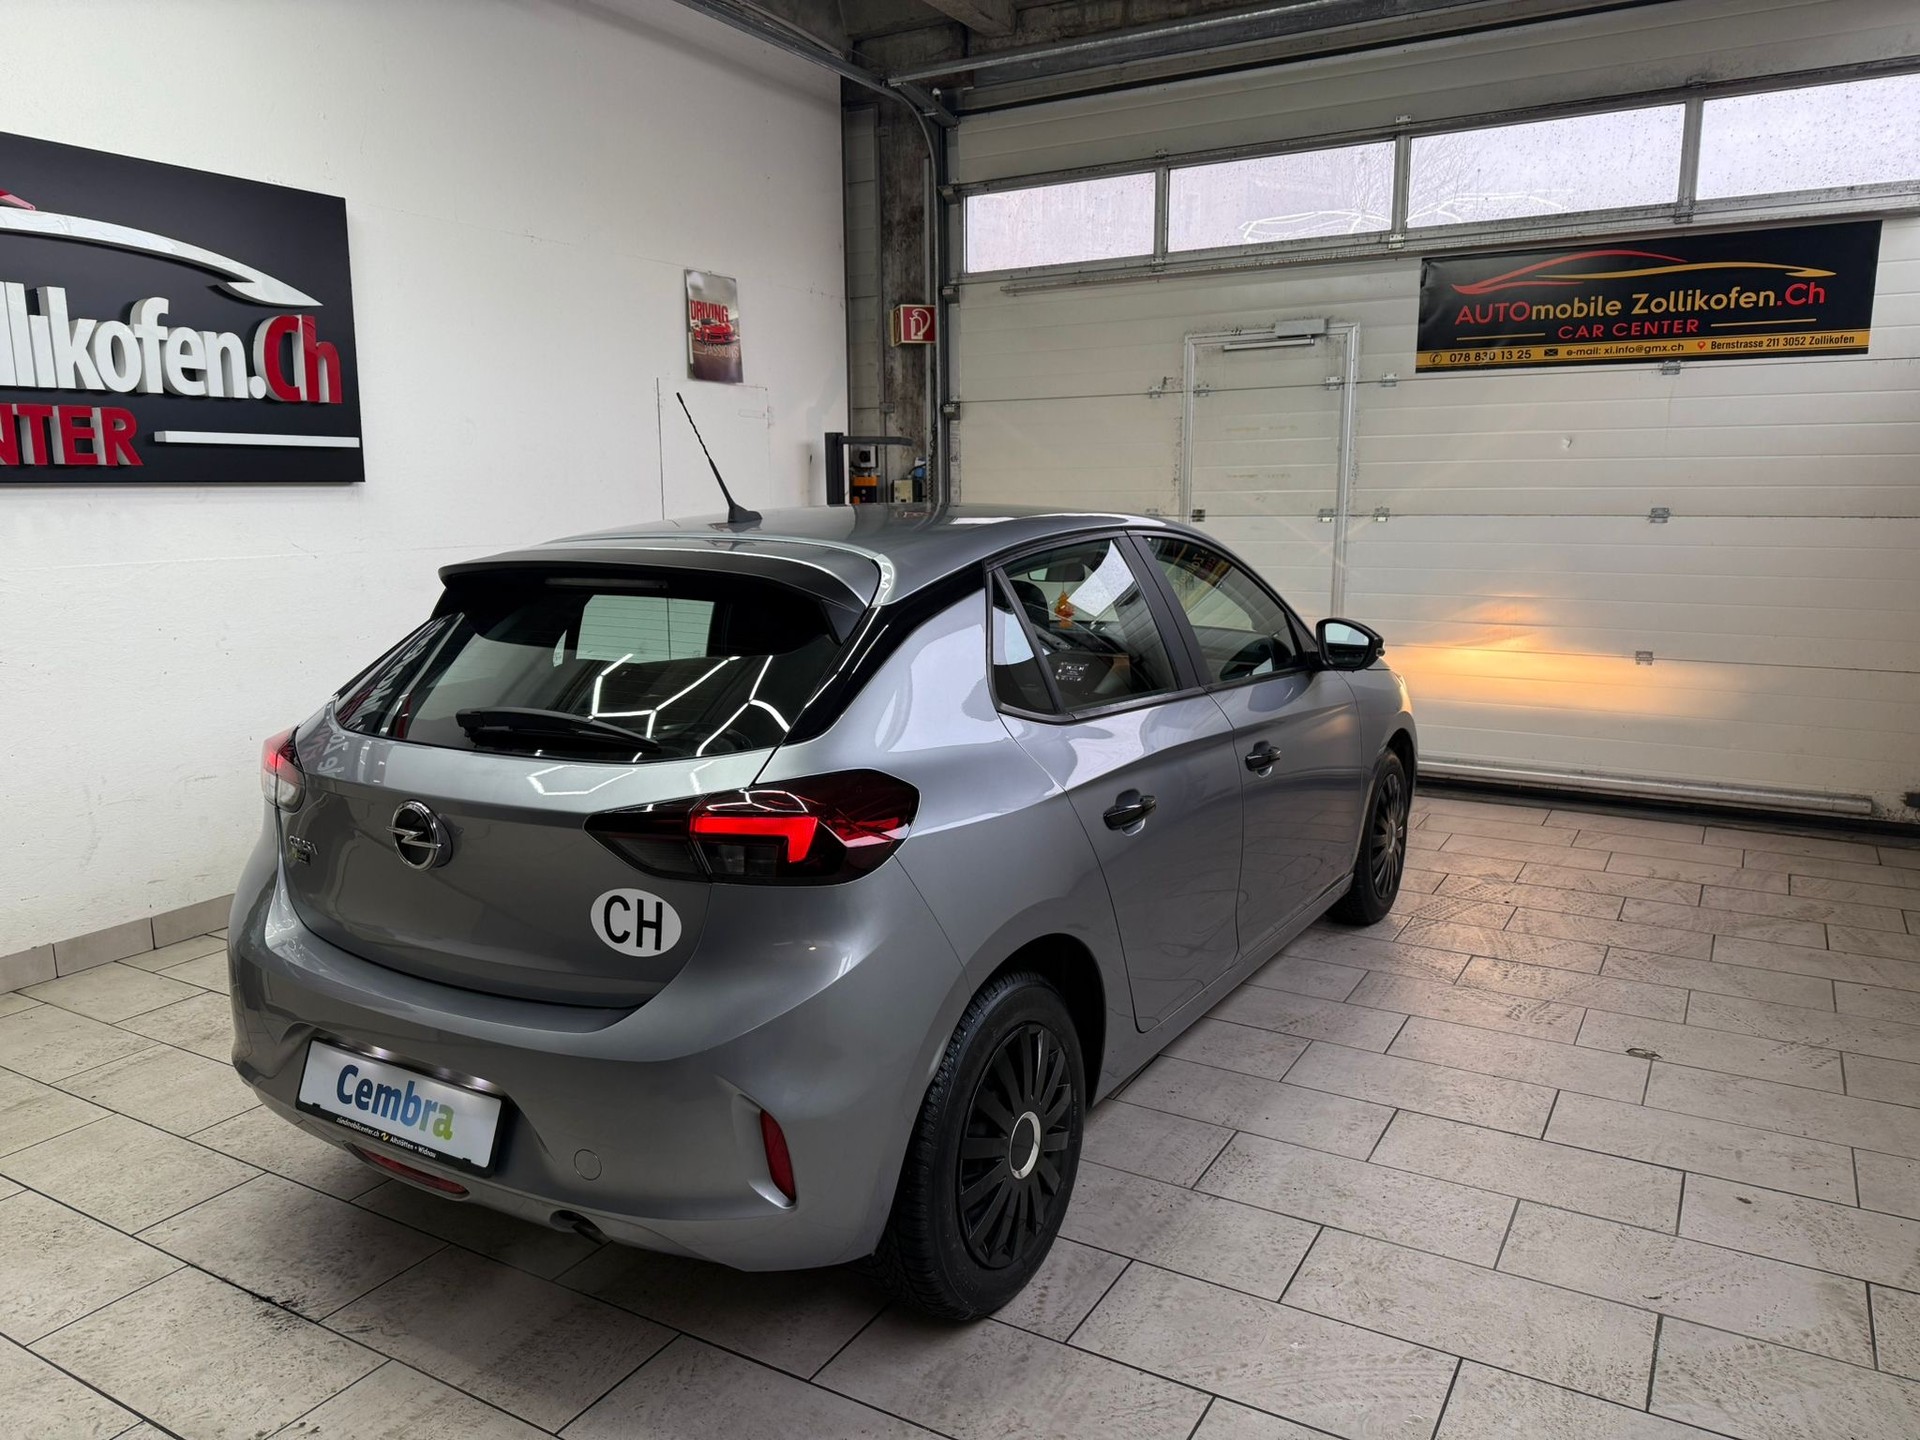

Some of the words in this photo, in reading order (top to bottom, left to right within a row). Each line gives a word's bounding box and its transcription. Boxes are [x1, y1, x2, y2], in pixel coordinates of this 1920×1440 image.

[690, 300, 729, 323] DRIVING
[1455, 295, 1622, 325] AUTOmobile
[1631, 282, 1826, 315] Zollikofen.Ch
[1558, 324, 1605, 339] CAR
[1612, 319, 1700, 336] CENTER
[1449, 353, 1471, 363] 078
[1501, 350, 1513, 360] 13
[1517, 349, 1532, 360] 25
[1566, 348, 1601, 356] e-mail:
[1604, 343, 1685, 355] xi.info@gmx.ch
[1710, 340, 1764, 350] Bernstrasse
[1766, 338, 1780, 348] 211
[1782, 336, 1807, 347] 3052
[1809, 334, 1855, 345] Zollikofen
[603, 894, 663, 951] CH
[336, 1064, 455, 1141] Cembra
